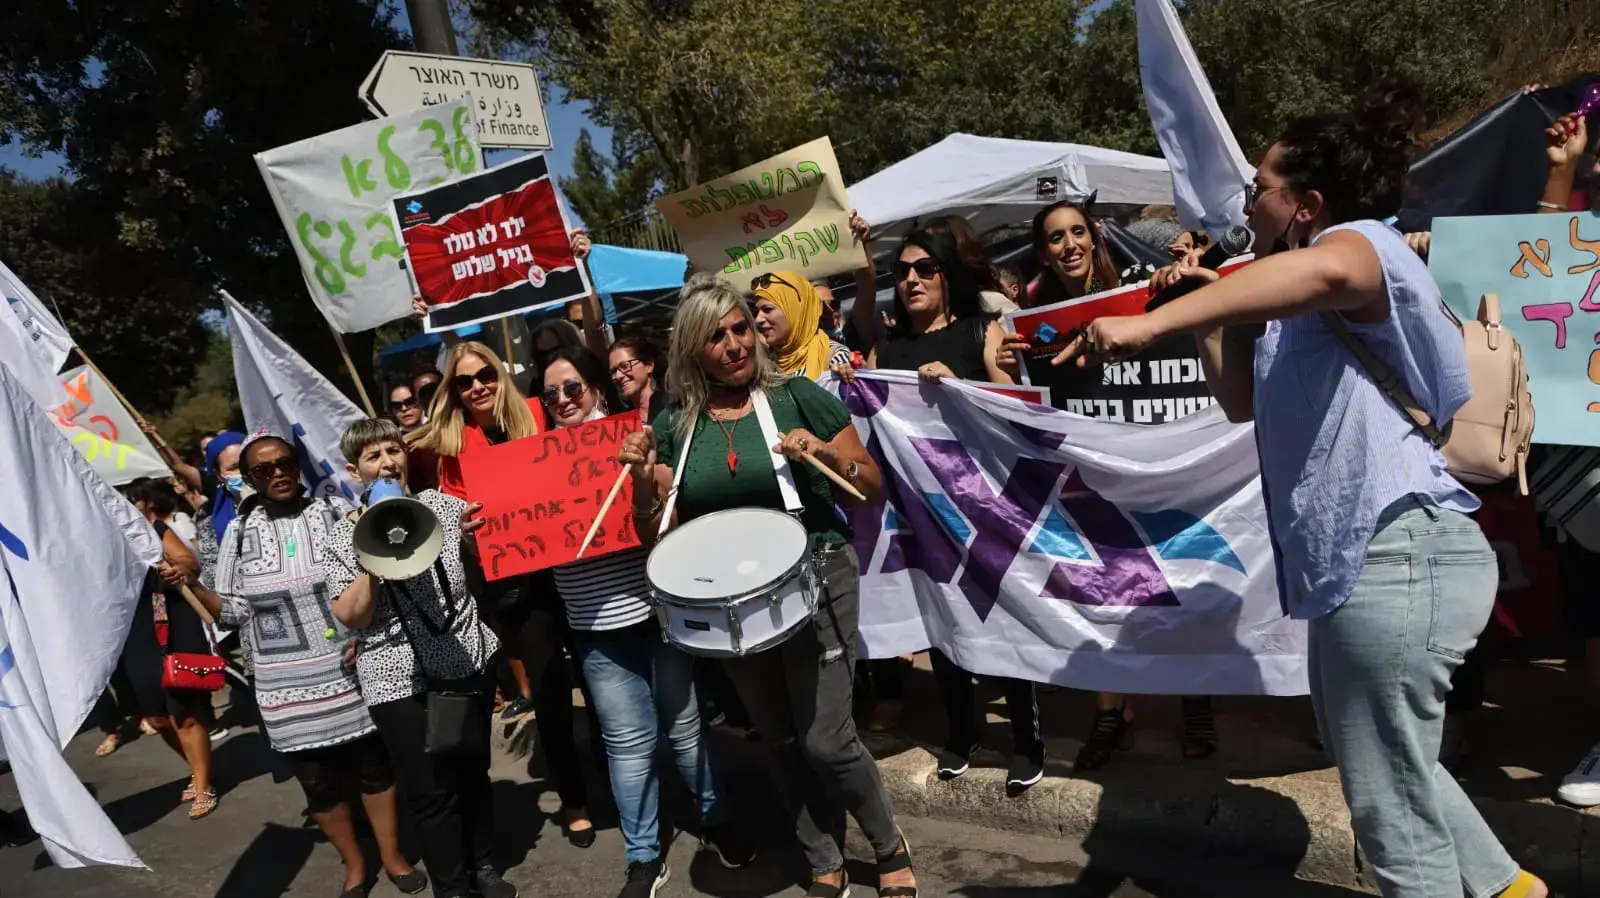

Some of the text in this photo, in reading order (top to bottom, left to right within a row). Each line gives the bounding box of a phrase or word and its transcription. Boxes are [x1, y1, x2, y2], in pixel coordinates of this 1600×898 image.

[408, 66, 520, 90] משרד האוצר
[478, 96, 522, 118] وزارة
[489, 119, 540, 136] Finance
[341, 125, 411, 198] לא
[679, 160, 824, 218] המטפלות
[443, 216, 526, 255] ילד לא נולד
[740, 205, 789, 234] לא
[452, 244, 534, 281] בגיל שלוש
[724, 223, 840, 273] שקופות
[480, 498, 565, 538] אחריות
